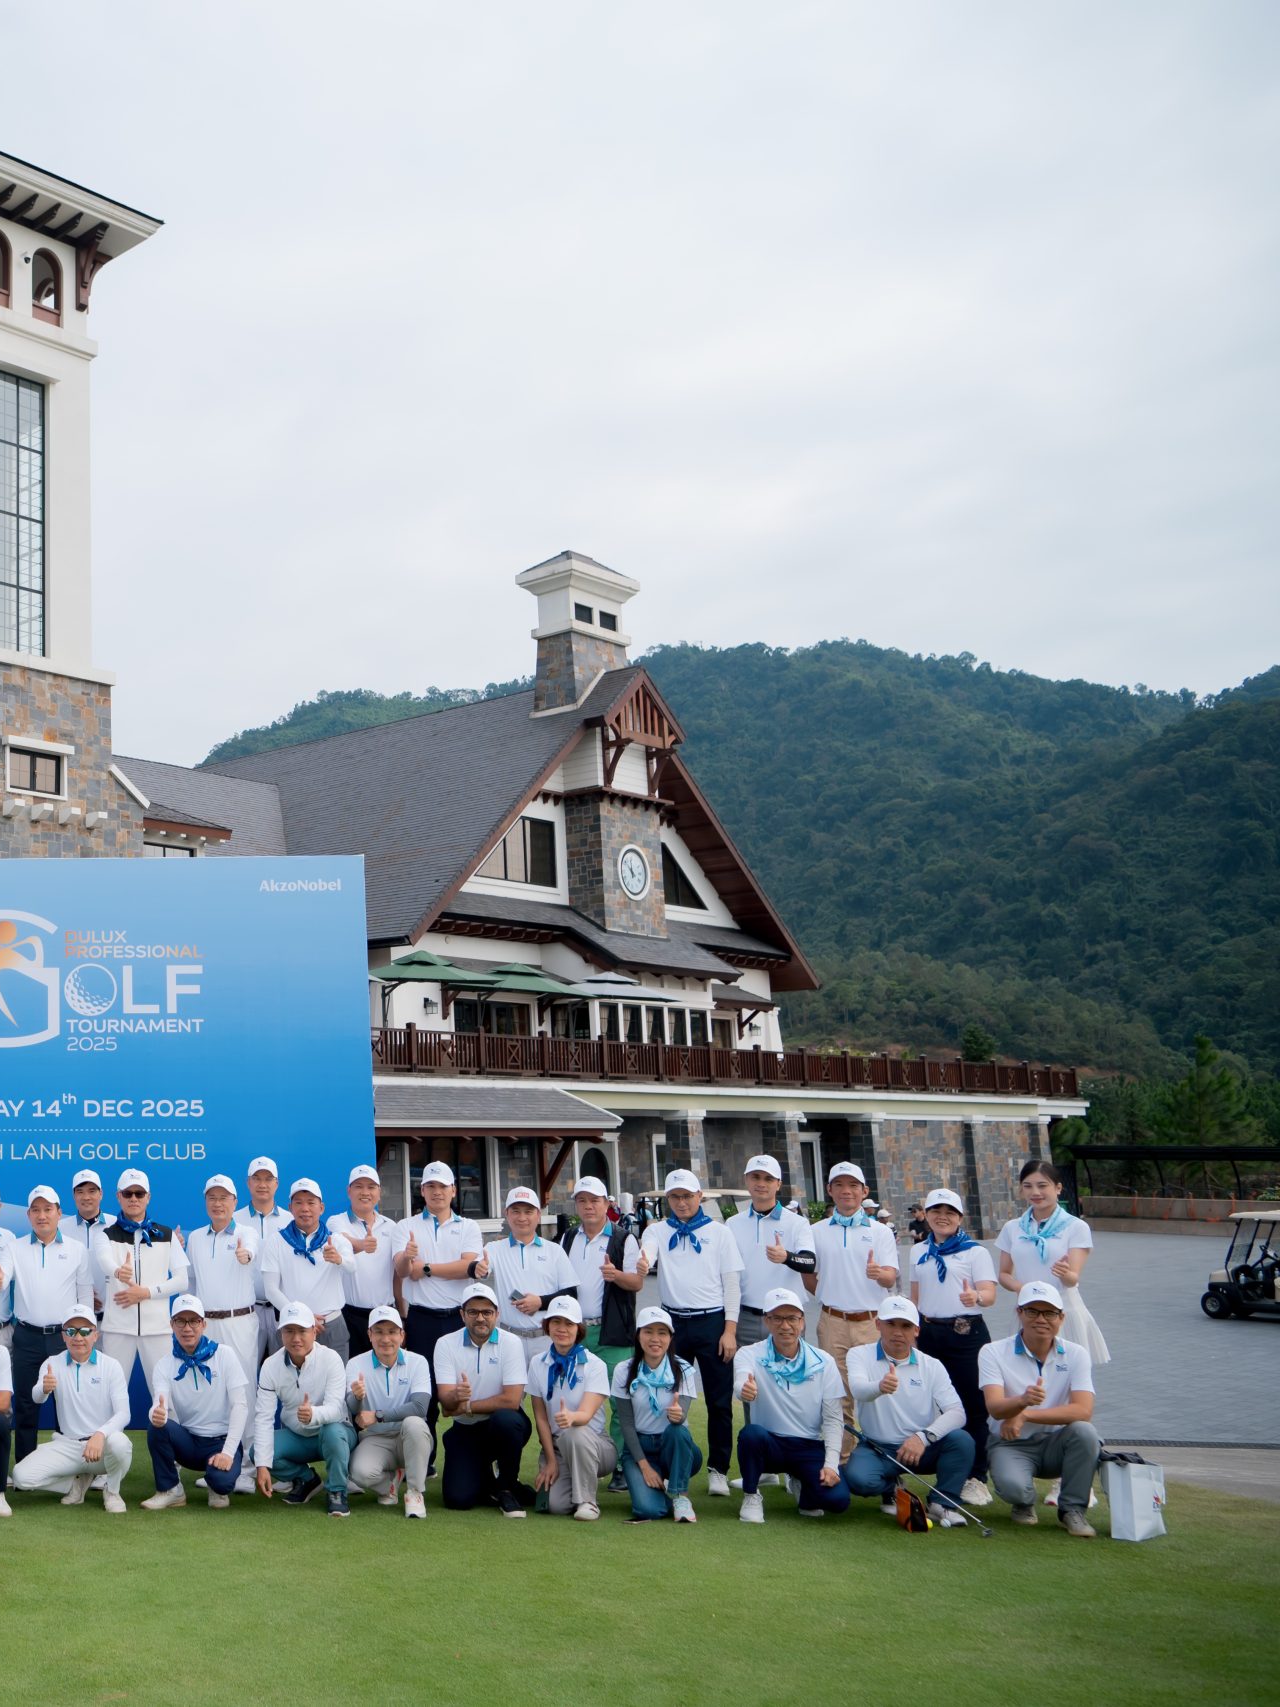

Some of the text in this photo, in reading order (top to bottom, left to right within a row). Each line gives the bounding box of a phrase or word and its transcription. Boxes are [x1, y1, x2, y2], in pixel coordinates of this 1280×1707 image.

[259, 879, 342, 892] AkzoNobel
[65, 930, 127, 944] DULUX
[65, 945, 203, 959] PROFESSIONAL
[66, 1019, 205, 1033] TOURNAMENT
[67, 1037, 118, 1051] 2025
[83, 1100, 134, 1117] DEC
[141, 1100, 205, 1117] 2025
[10, 1143, 71, 1160] LANH
[79, 1143, 140, 1160] GOLF
[146, 1143, 207, 1160] CLUB
